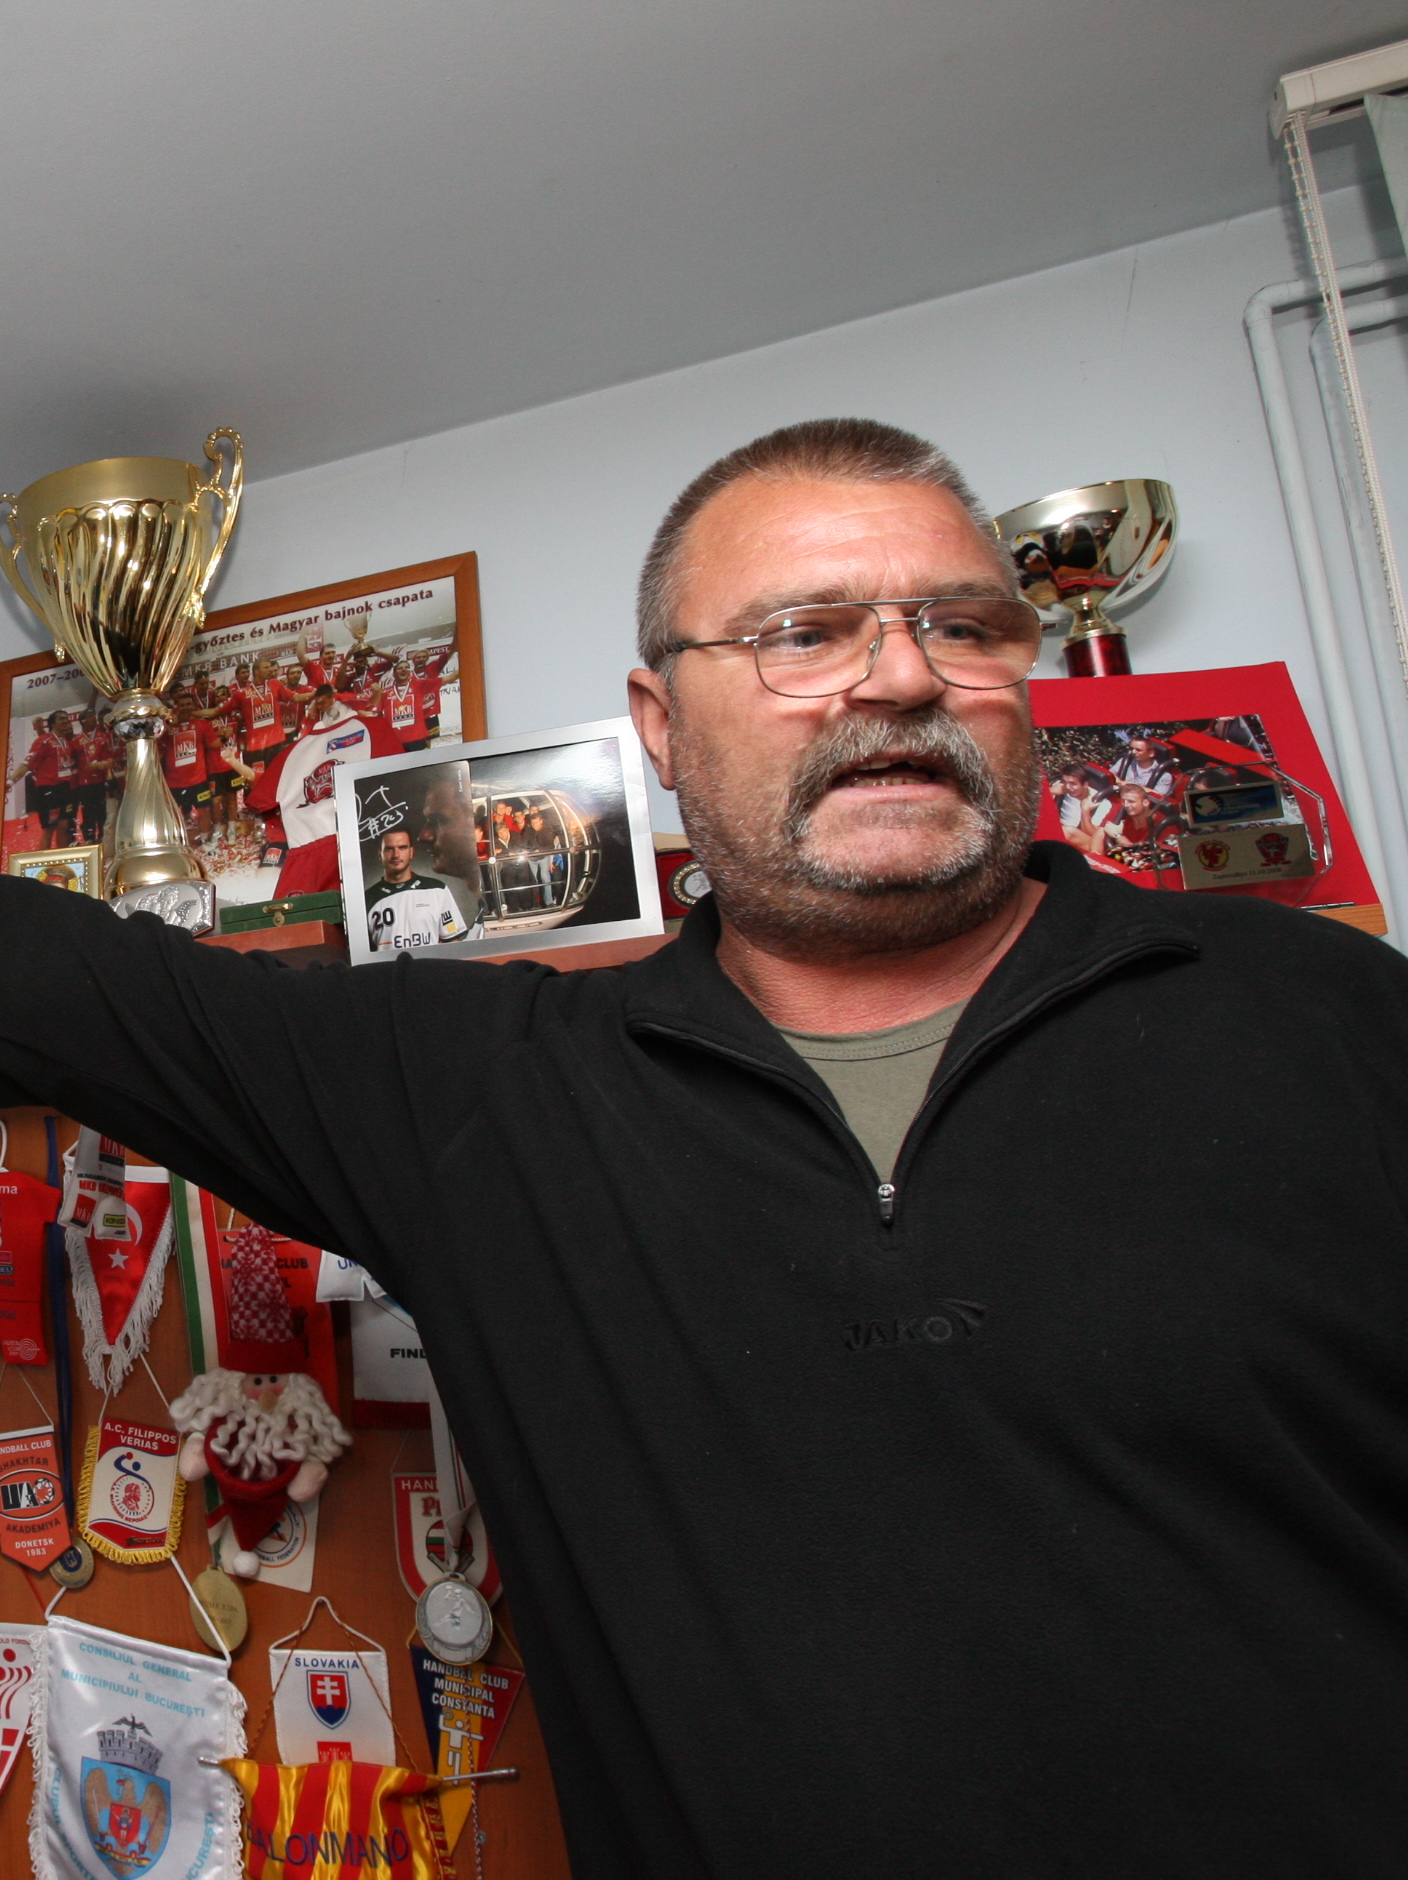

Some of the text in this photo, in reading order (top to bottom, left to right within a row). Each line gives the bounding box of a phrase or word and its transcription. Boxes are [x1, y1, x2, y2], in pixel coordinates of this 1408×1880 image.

[249, 626, 264, 638] és
[268, 614, 320, 633] Magyar
[324, 600, 373, 621] bajnok
[378, 589, 434, 610] csapata
[219, 651, 260, 669] BANK
[371, 907, 395, 930] 20
[394, 932, 431, 948] EnBW
[276, 1258, 309, 1269] CLUB
[104, 1422, 177, 1444] A.C. FILIPPOS
[30, 1440, 52, 1450] CLUB
[120, 1435, 159, 1450] VERIAS
[5, 1518, 61, 1534] AKADEMIYA
[15, 1538, 54, 1549] DONETSK
[26, 1548, 46, 1556] 1983
[79, 1642, 192, 1682] CONSILIUL GENERAL
[295, 1657, 360, 1669] SLOVAKIA
[61, 1669, 139, 1698] MUNICIPIULUI
[128, 1672, 142, 1684] AL
[480, 1673, 509, 1690] CLUB
[434, 1678, 495, 1703] MUNICIPAL
[432, 1693, 495, 1719] CONSTANTA
